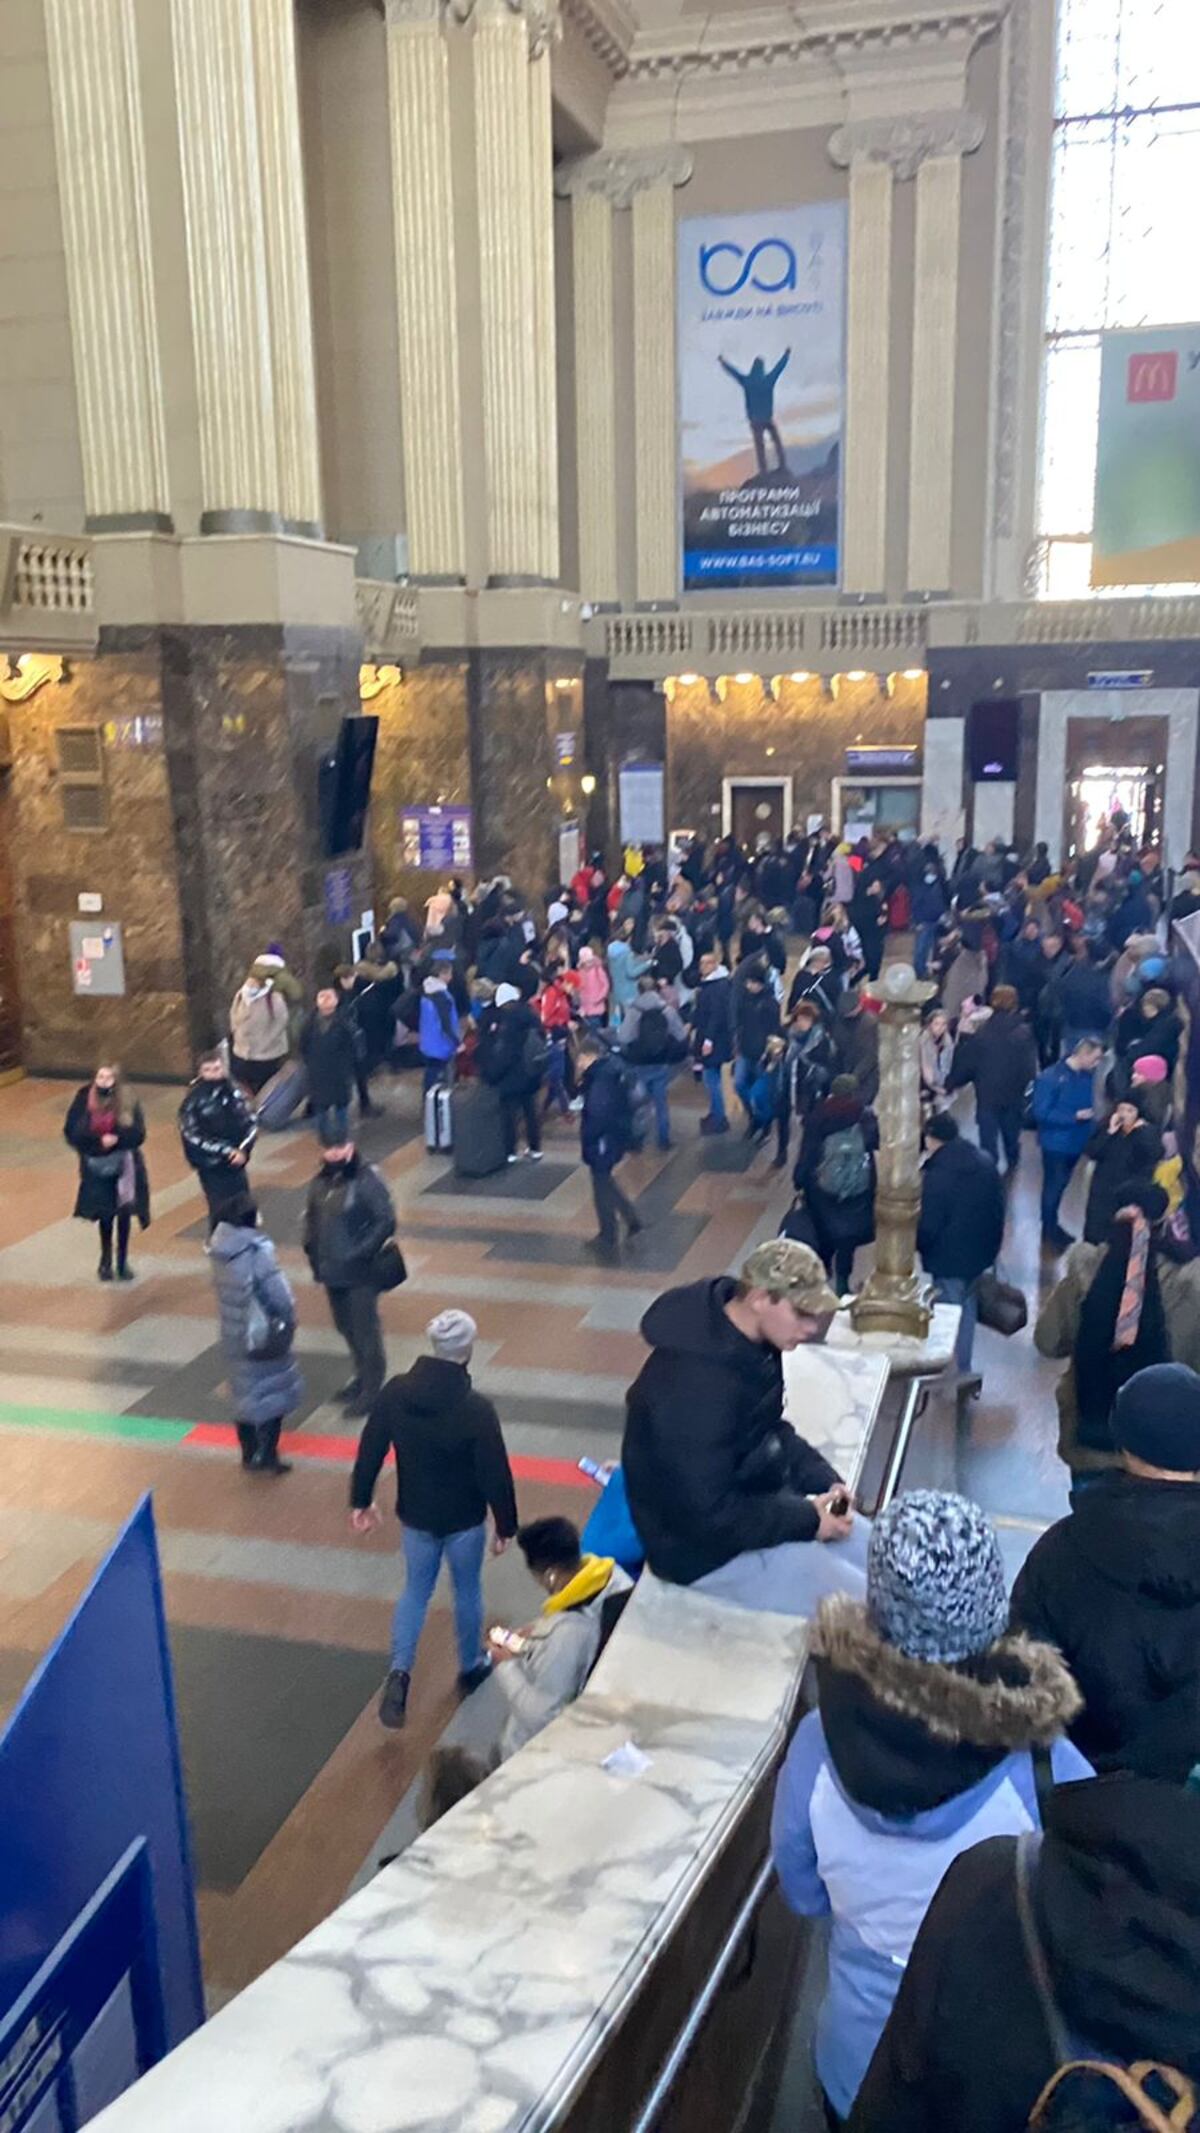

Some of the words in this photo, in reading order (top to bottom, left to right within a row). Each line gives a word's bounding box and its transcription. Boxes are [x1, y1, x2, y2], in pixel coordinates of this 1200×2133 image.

[718, 486, 800, 504] ПРОГРАМИ
[699, 498, 821, 521] АВТОМАТИЗАЦІЇ
[727, 520, 791, 537] БІЗНЕСУ
